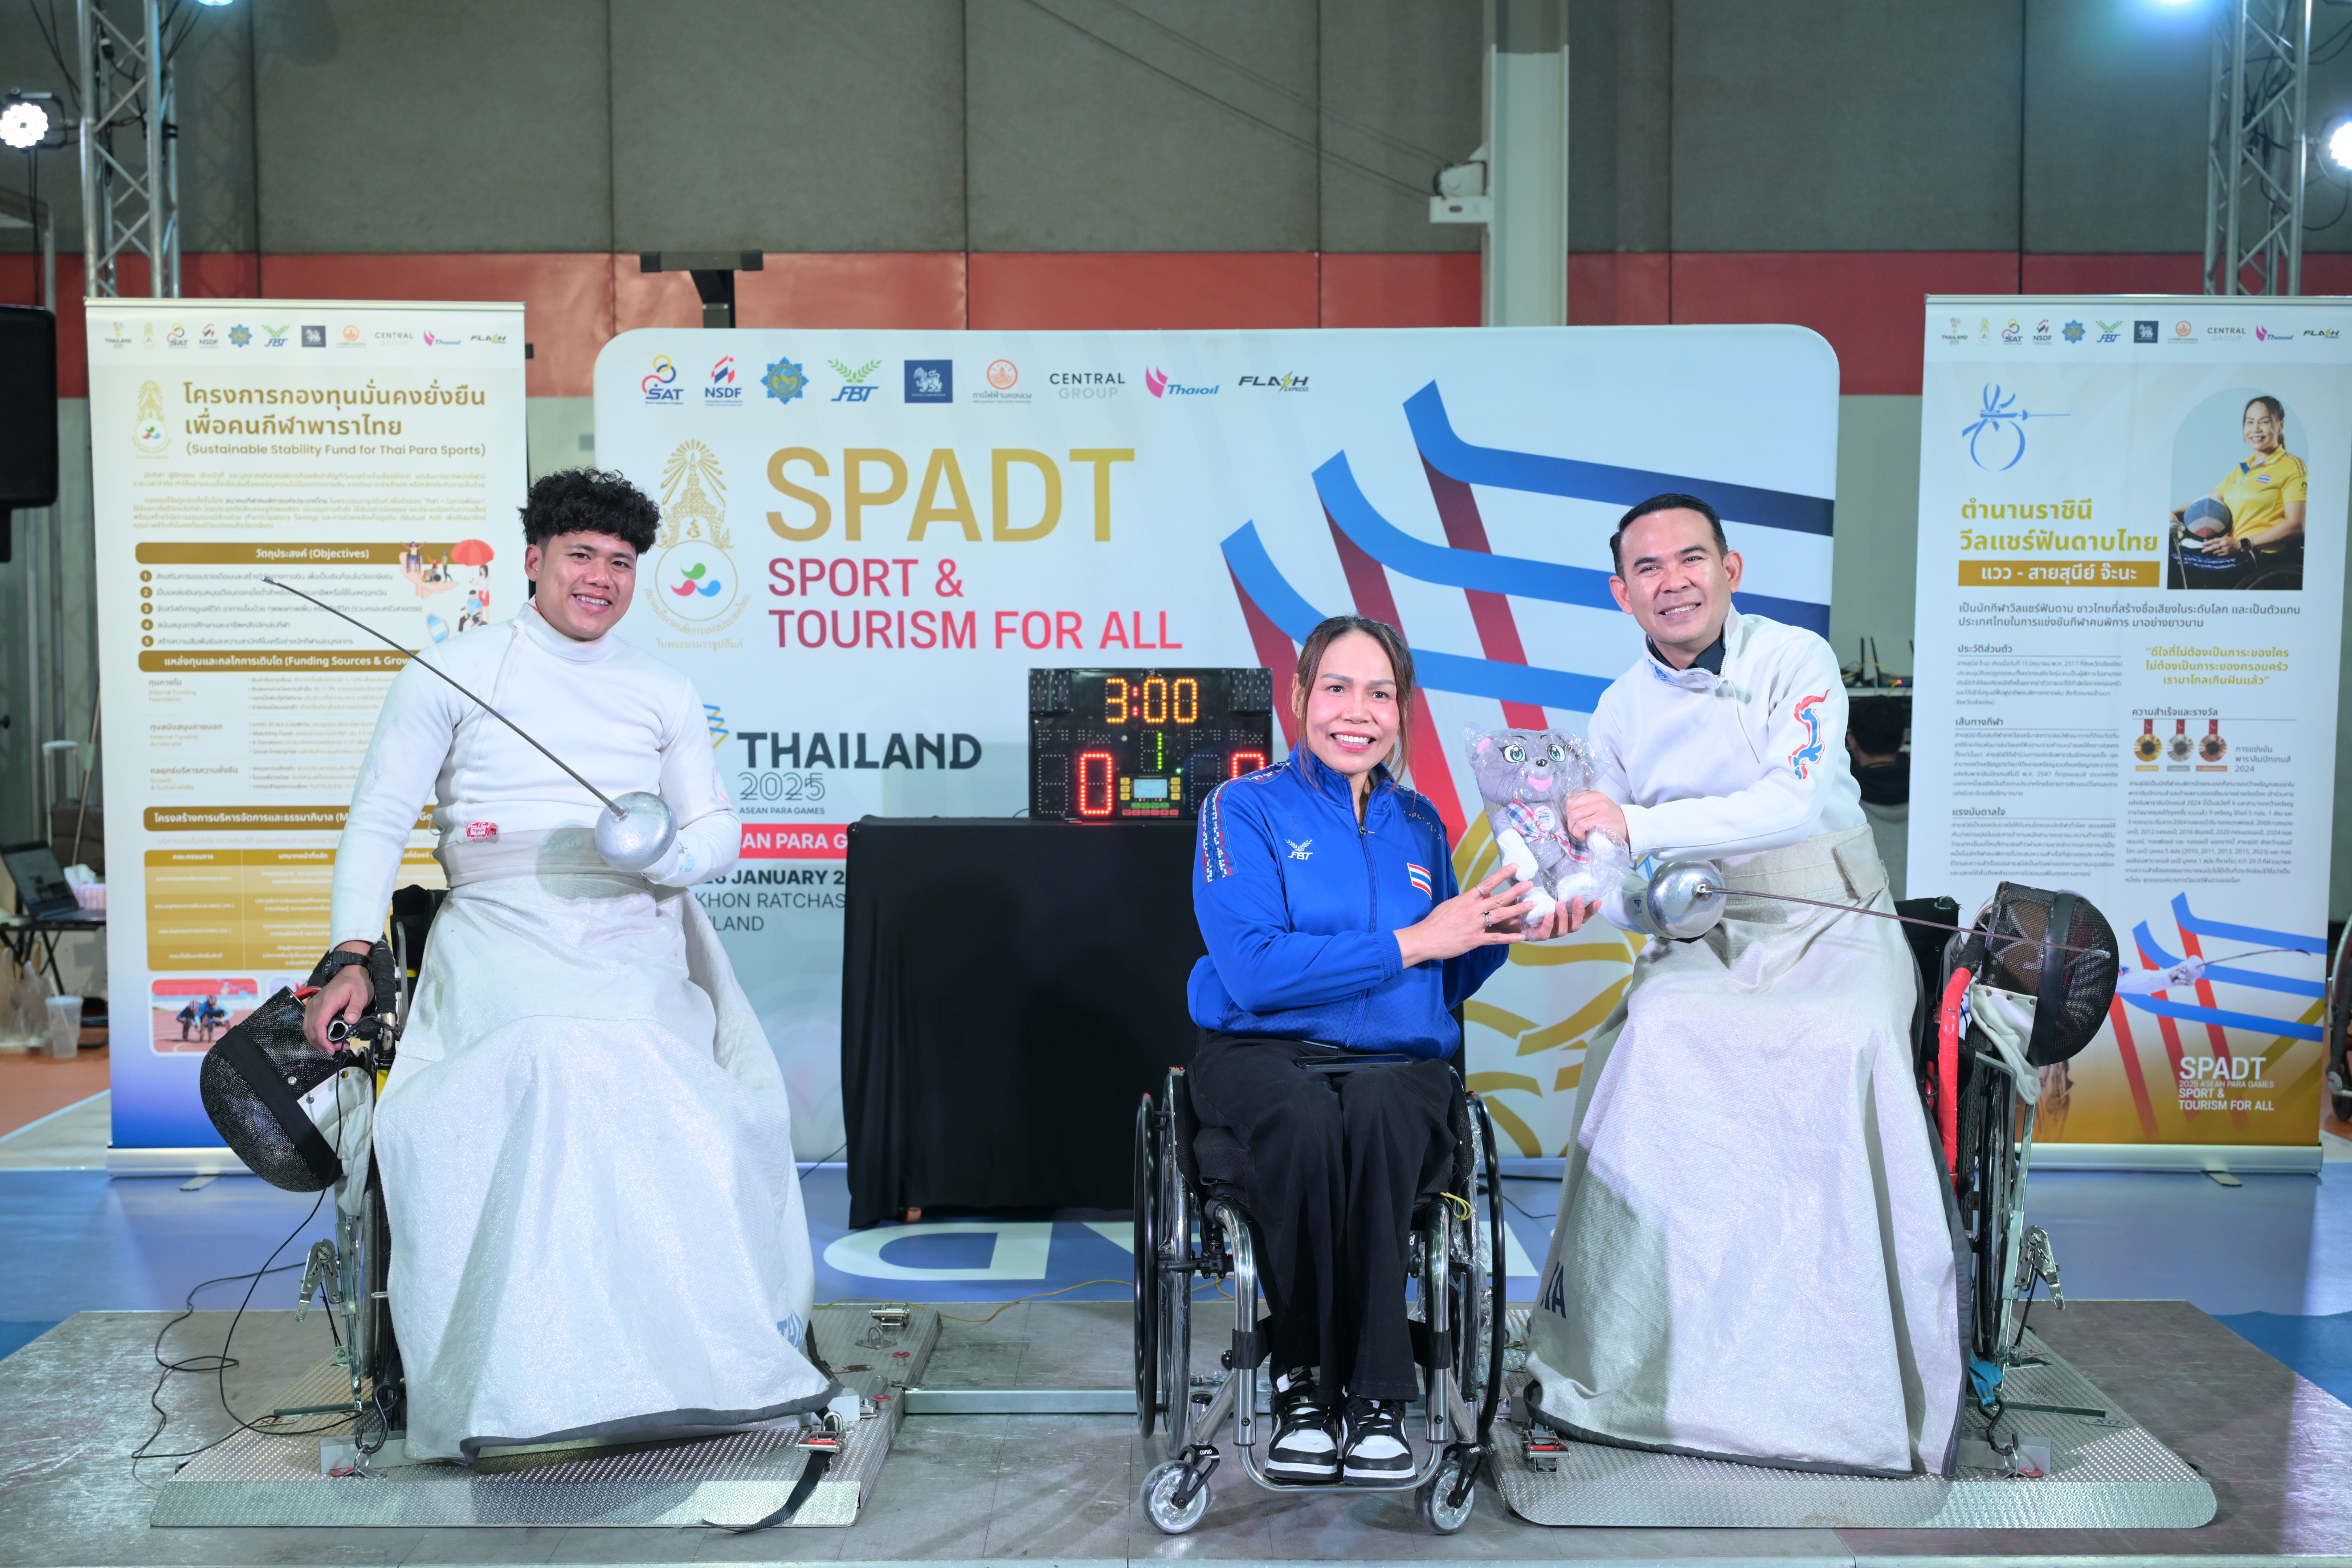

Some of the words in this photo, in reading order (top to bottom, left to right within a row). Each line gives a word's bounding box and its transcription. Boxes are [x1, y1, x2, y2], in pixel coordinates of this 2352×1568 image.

[2096, 334, 2121, 342] FBT
[1050, 373, 1126, 385] CENTRAL
[183, 379, 484, 411] โครงการกองทุนมั่นคงยั่งยืน
[646, 387, 684, 400] SAT
[705, 387, 742, 398] NSDF
[831, 385, 879, 402] FBT
[1059, 387, 1118, 399] GROUP
[186, 407, 401, 435] เพื่อคนกีฬาพาราไทย
[187, 442, 268, 455] (Sustainable
[271, 444, 321, 457] Stability
[325, 445, 356, 454] Fund
[360, 444, 375, 454] for
[380, 445, 405, 455] Thai
[409, 446, 437, 455] Para
[441, 443, 485, 458] Sports)
[766, 446, 1134, 542] SPADT
[1962, 497, 2092, 520] ตำนานราชินี
[1960, 529, 2158, 551] วีลแชร์ฟันดาบไทย
[309, 549, 369, 560] (Objectives)
[768, 557, 918, 598] SPORT
[935, 558, 963, 597] &
[1982, 567, 2011, 579] แวว
[2028, 563, 2096, 582] สายสุนีย์
[1959, 602, 2073, 612] เป็นนักกีฬาวีลแชร์ฟันดาบ
[2077, 601, 2228, 614] ชาวไทยที่สร้างชื่อเสียงในระดับโลก
[2232, 603, 2300, 614] และเป็นตัวแทน
[1959, 616, 2129, 627] ประเทศไทยในการแข่งขันกีฬาคนพิการ
[2133, 617, 2203, 627] มาอย่างยาวนาน
[768, 609, 977, 649] TOURISM
[995, 610, 1084, 649] FOR
[1099, 611, 1183, 650] ALL
[1958, 644, 2012, 652] ประวัติส่วนตัว
[285, 655, 329, 668] (Funding
[332, 655, 371, 665] Sources
[373, 655, 382, 665] &
[2146, 660, 2288, 671] ไม่ต้องเป็นภาระของครอบครัว
[1106, 679, 1197, 724] 3:00
[2132, 707, 2218, 716] ความสำเร็จและรางวัล
[1955, 717, 2003, 725] เส้นทางกีฬา
[736, 732, 982, 770] THAILAND
[738, 771, 826, 801] 2025
[1080, 752, 1113, 815] 0
[1953, 807, 2005, 815] แรงบันดาลใจ
[776, 833, 829, 850] PARA
[1288, 852, 1313, 860] FBT
[731, 869, 828, 885] JANUARY
[2179, 1057, 2266, 1080] SPADT
[2248, 1080, 2274, 1089] GAMES
[2179, 1089, 2215, 1099] SPORT
[2218, 1089, 2225, 1098] &
[2179, 1100, 2227, 1110] TOURISM
[2231, 1100, 2252, 1110] FOR
[2255, 1100, 2275, 1110] ALL
